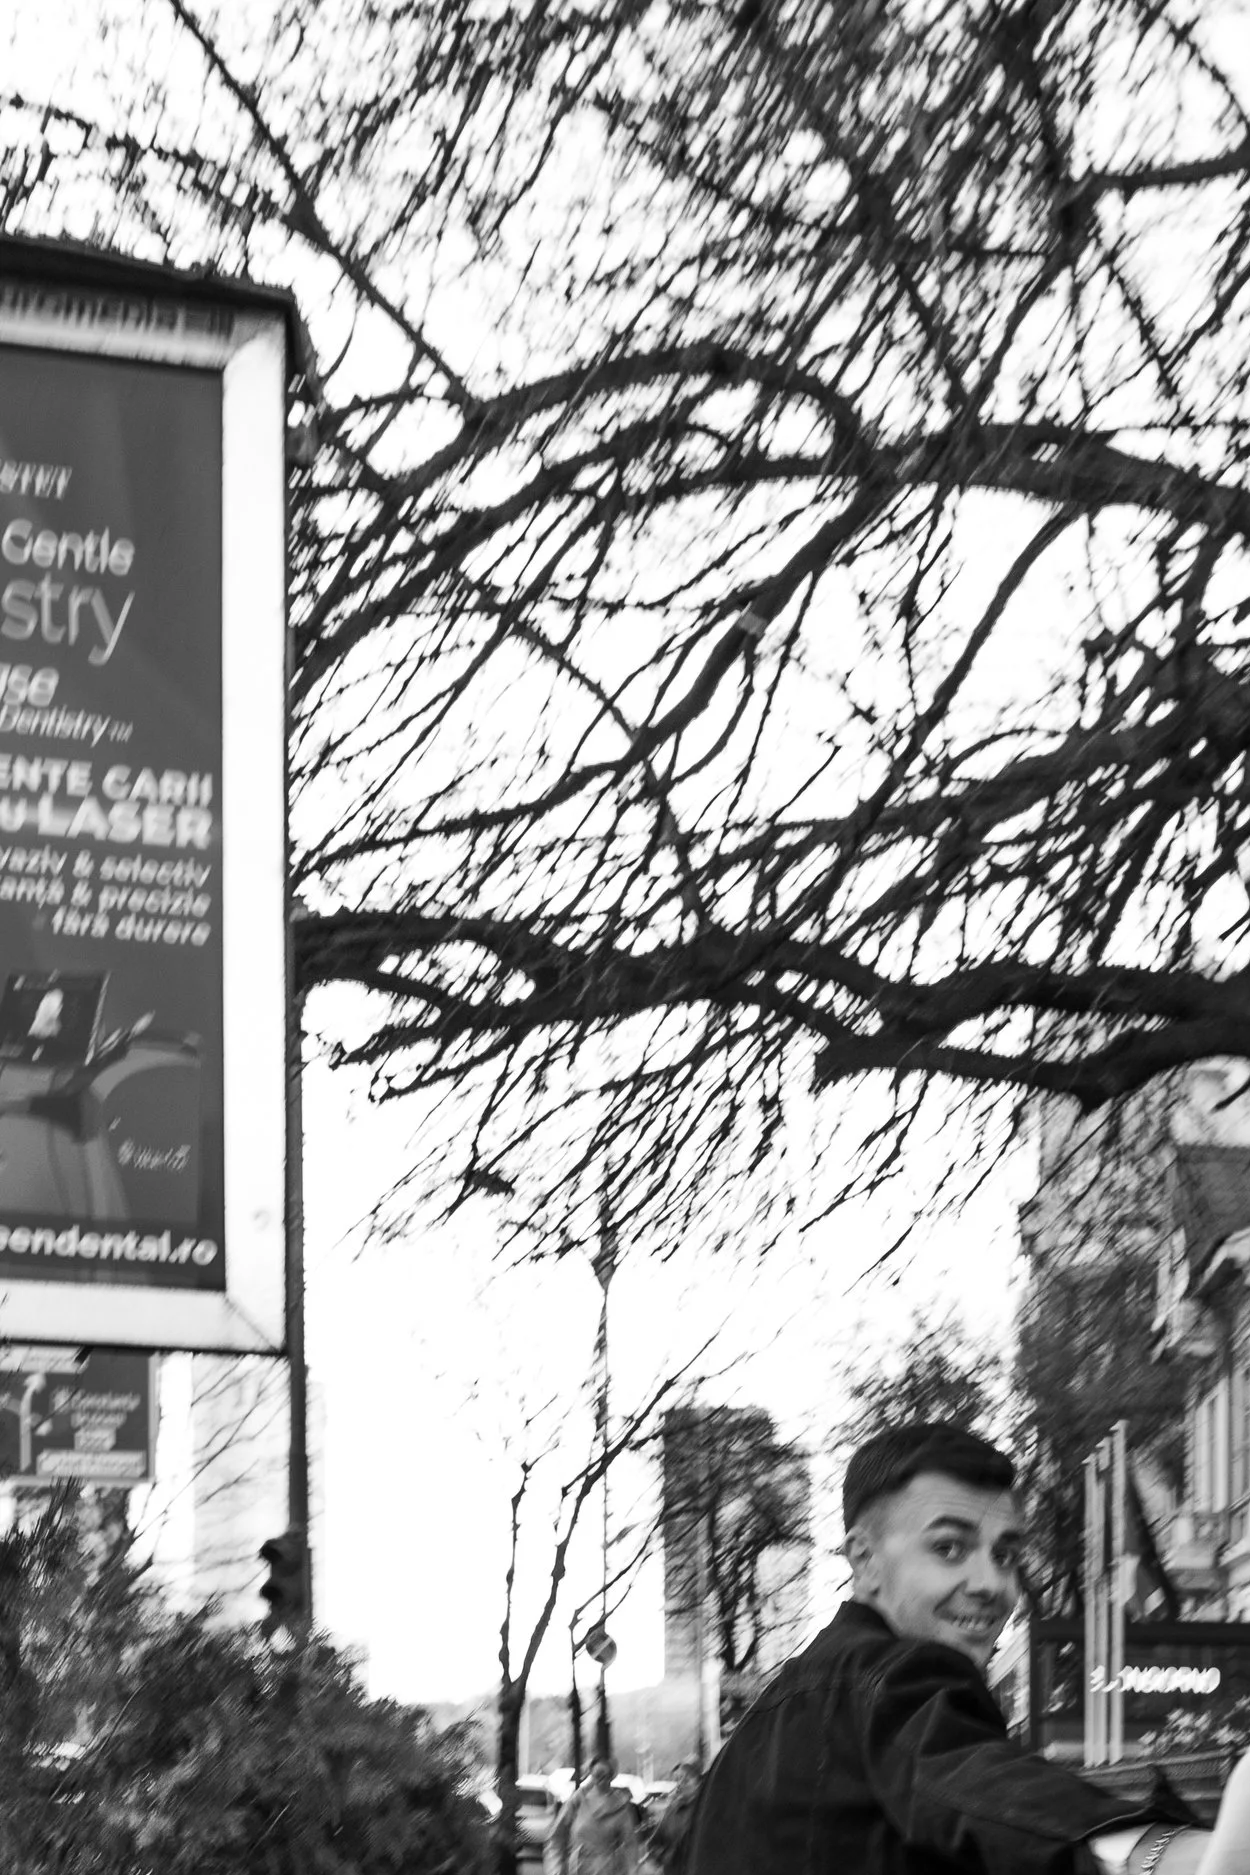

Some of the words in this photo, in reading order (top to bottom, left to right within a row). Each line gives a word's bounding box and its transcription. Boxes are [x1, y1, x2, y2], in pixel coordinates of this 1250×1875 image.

[2, 518, 136, 576] Gentle
[1, 571, 136, 666] stry
[37, 791, 213, 850] LASER
[115, 912, 212, 947] durere
